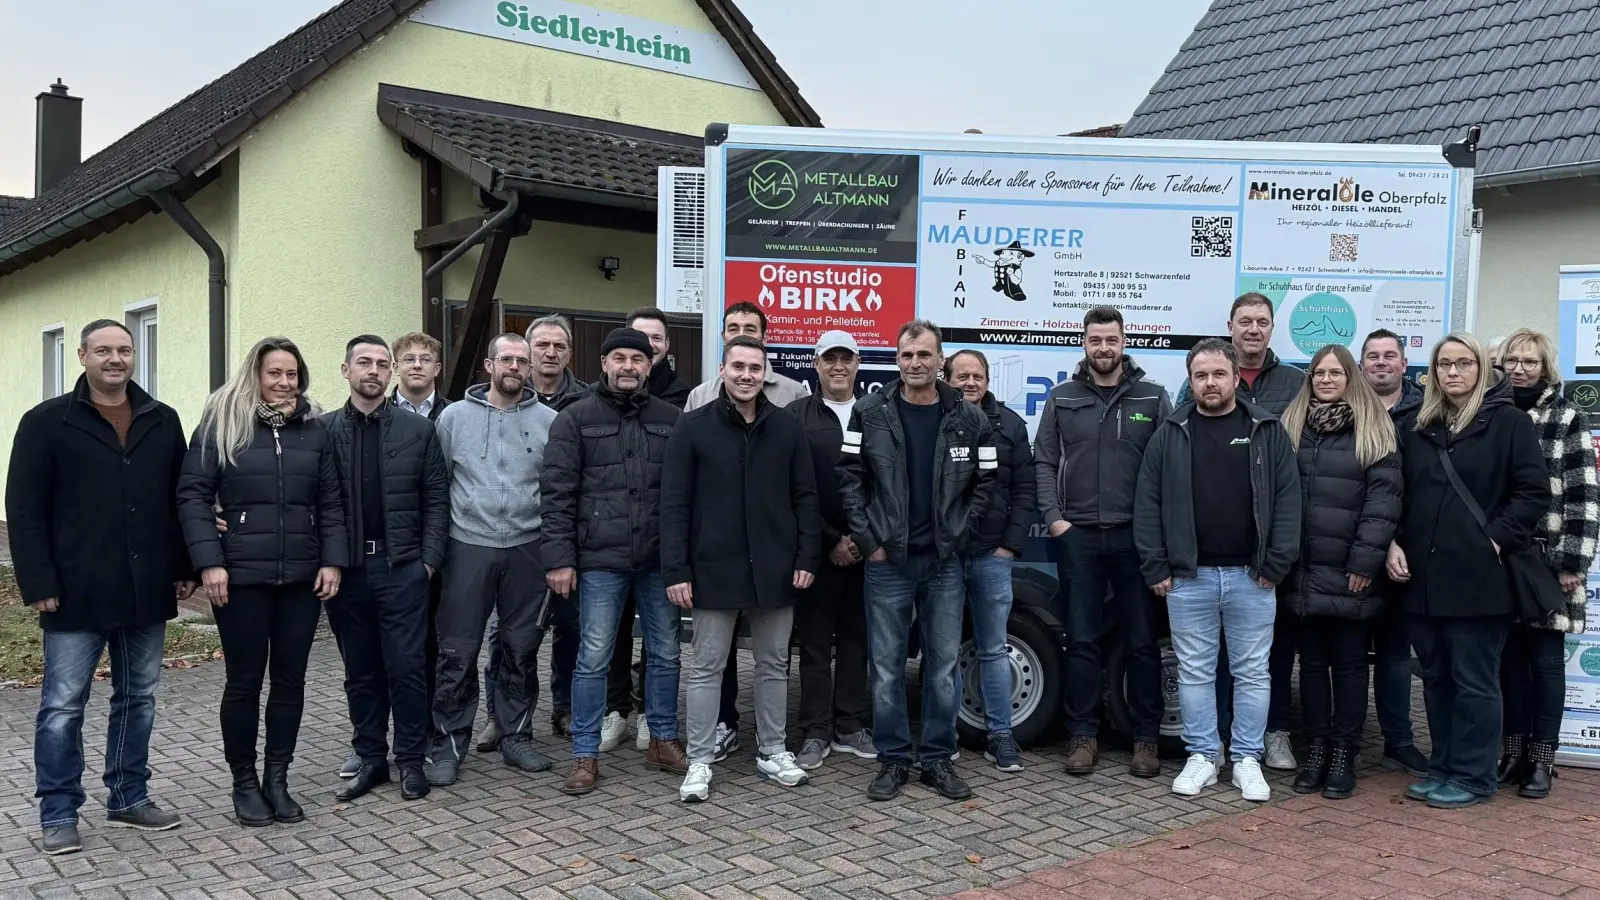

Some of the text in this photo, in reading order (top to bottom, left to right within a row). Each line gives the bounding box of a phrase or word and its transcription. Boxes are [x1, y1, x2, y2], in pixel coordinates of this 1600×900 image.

[496, 1, 691, 64] Siedlerheim
[805, 172, 898, 188] METALLBAU
[933, 167, 1233, 197] Wir danken allen Sponsoren für Ihre Teilnahme!
[813, 193, 889, 206] ALTMANN
[1378, 191, 1447, 207] Oberpfalz
[1292, 203, 1322, 211] HEIZÖL
[748, 218, 779, 226] GELÄNDER
[817, 220, 869, 229] ÜBERDACHUNGEN
[1277, 217, 1294, 225] Ihr
[1296, 218, 1343, 229] regionaler
[928, 224, 1083, 248] MAUDERER
[765, 243, 878, 254] WWW.METALLBAUALTMANN.DE
[1054, 251, 1083, 260] GmbH
[760, 264, 882, 286] Ofenstudio
[1054, 269, 1098, 278] Hertzstraße
[1110, 271, 1133, 279] 92521
[1135, 272, 1191, 280] Schwarzenfeld
[1258, 281, 1372, 293] Ihr Schuhhaus für die ganze Familie!
[780, 286, 862, 312] BIRK
[1083, 290, 1100, 298] 0171
[1300, 304, 1348, 313] Schuhhaus
[765, 314, 876, 327] Kamin- und Pelletöfen
[980, 317, 1029, 328] Zimmerei
[1124, 322, 1171, 334] chungen
[785, 361, 815, 370] Digital
